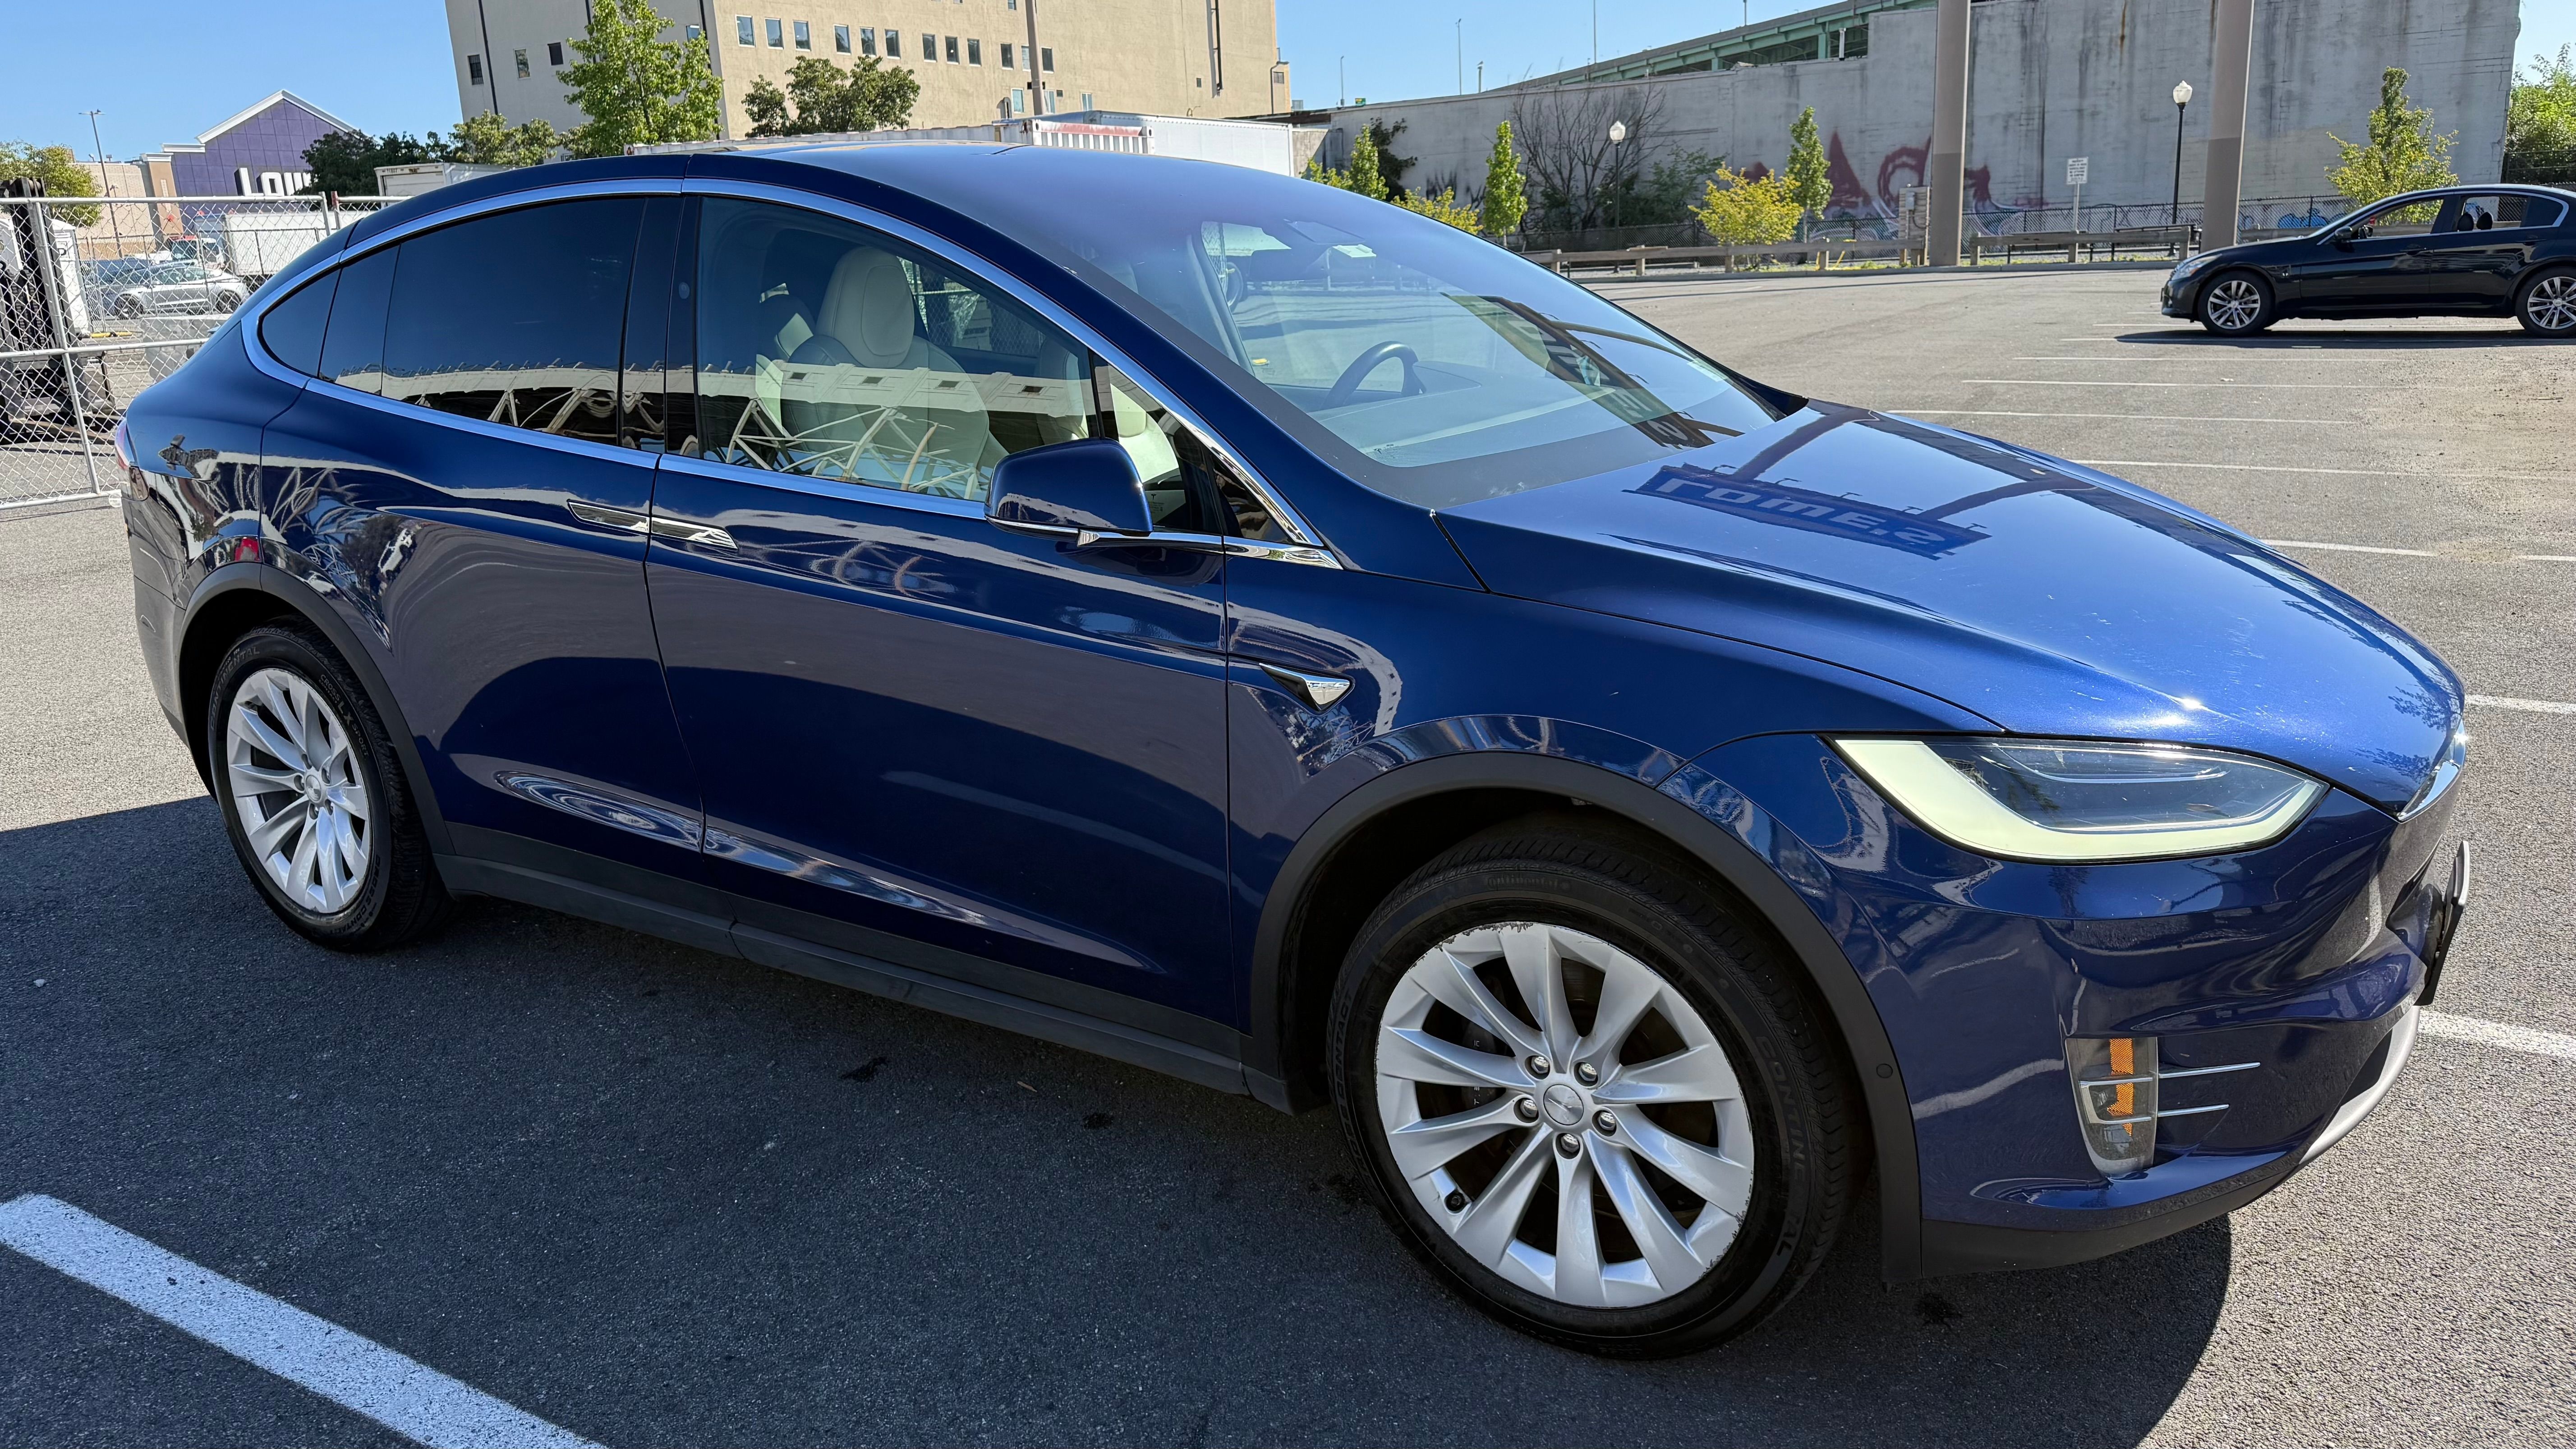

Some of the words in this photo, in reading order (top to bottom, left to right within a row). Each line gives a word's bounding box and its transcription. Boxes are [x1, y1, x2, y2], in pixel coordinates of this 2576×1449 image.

[234, 167, 312, 196] LOW
[211, 646, 260, 730] CONTINENTAL
[321, 674, 341, 701] CROSS
[338, 701, 354, 727] LX
[352, 723, 369, 757] SPORT
